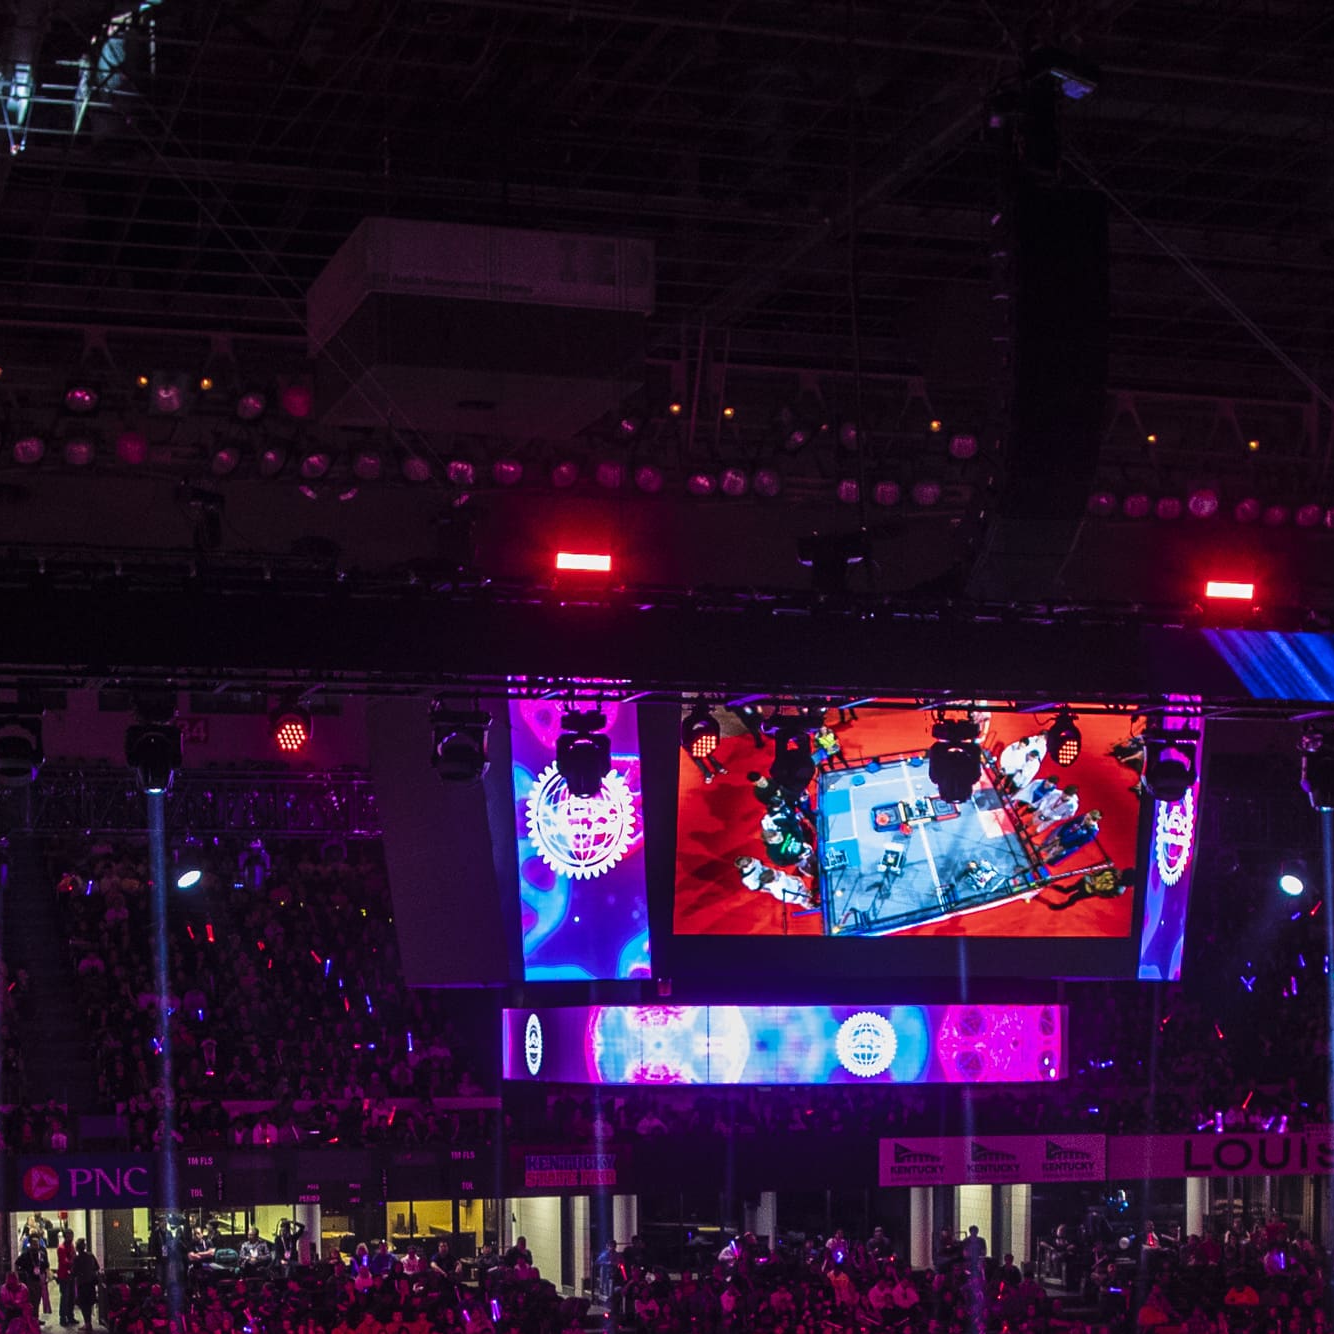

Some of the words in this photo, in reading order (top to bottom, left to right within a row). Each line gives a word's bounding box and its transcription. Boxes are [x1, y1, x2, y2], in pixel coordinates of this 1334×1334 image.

[525, 1154, 617, 1171] KENTUCKY
[890, 1165, 946, 1175] KENTUCKY
[67, 1166, 148, 1198] PNC
[525, 1170, 578, 1188] STATE
